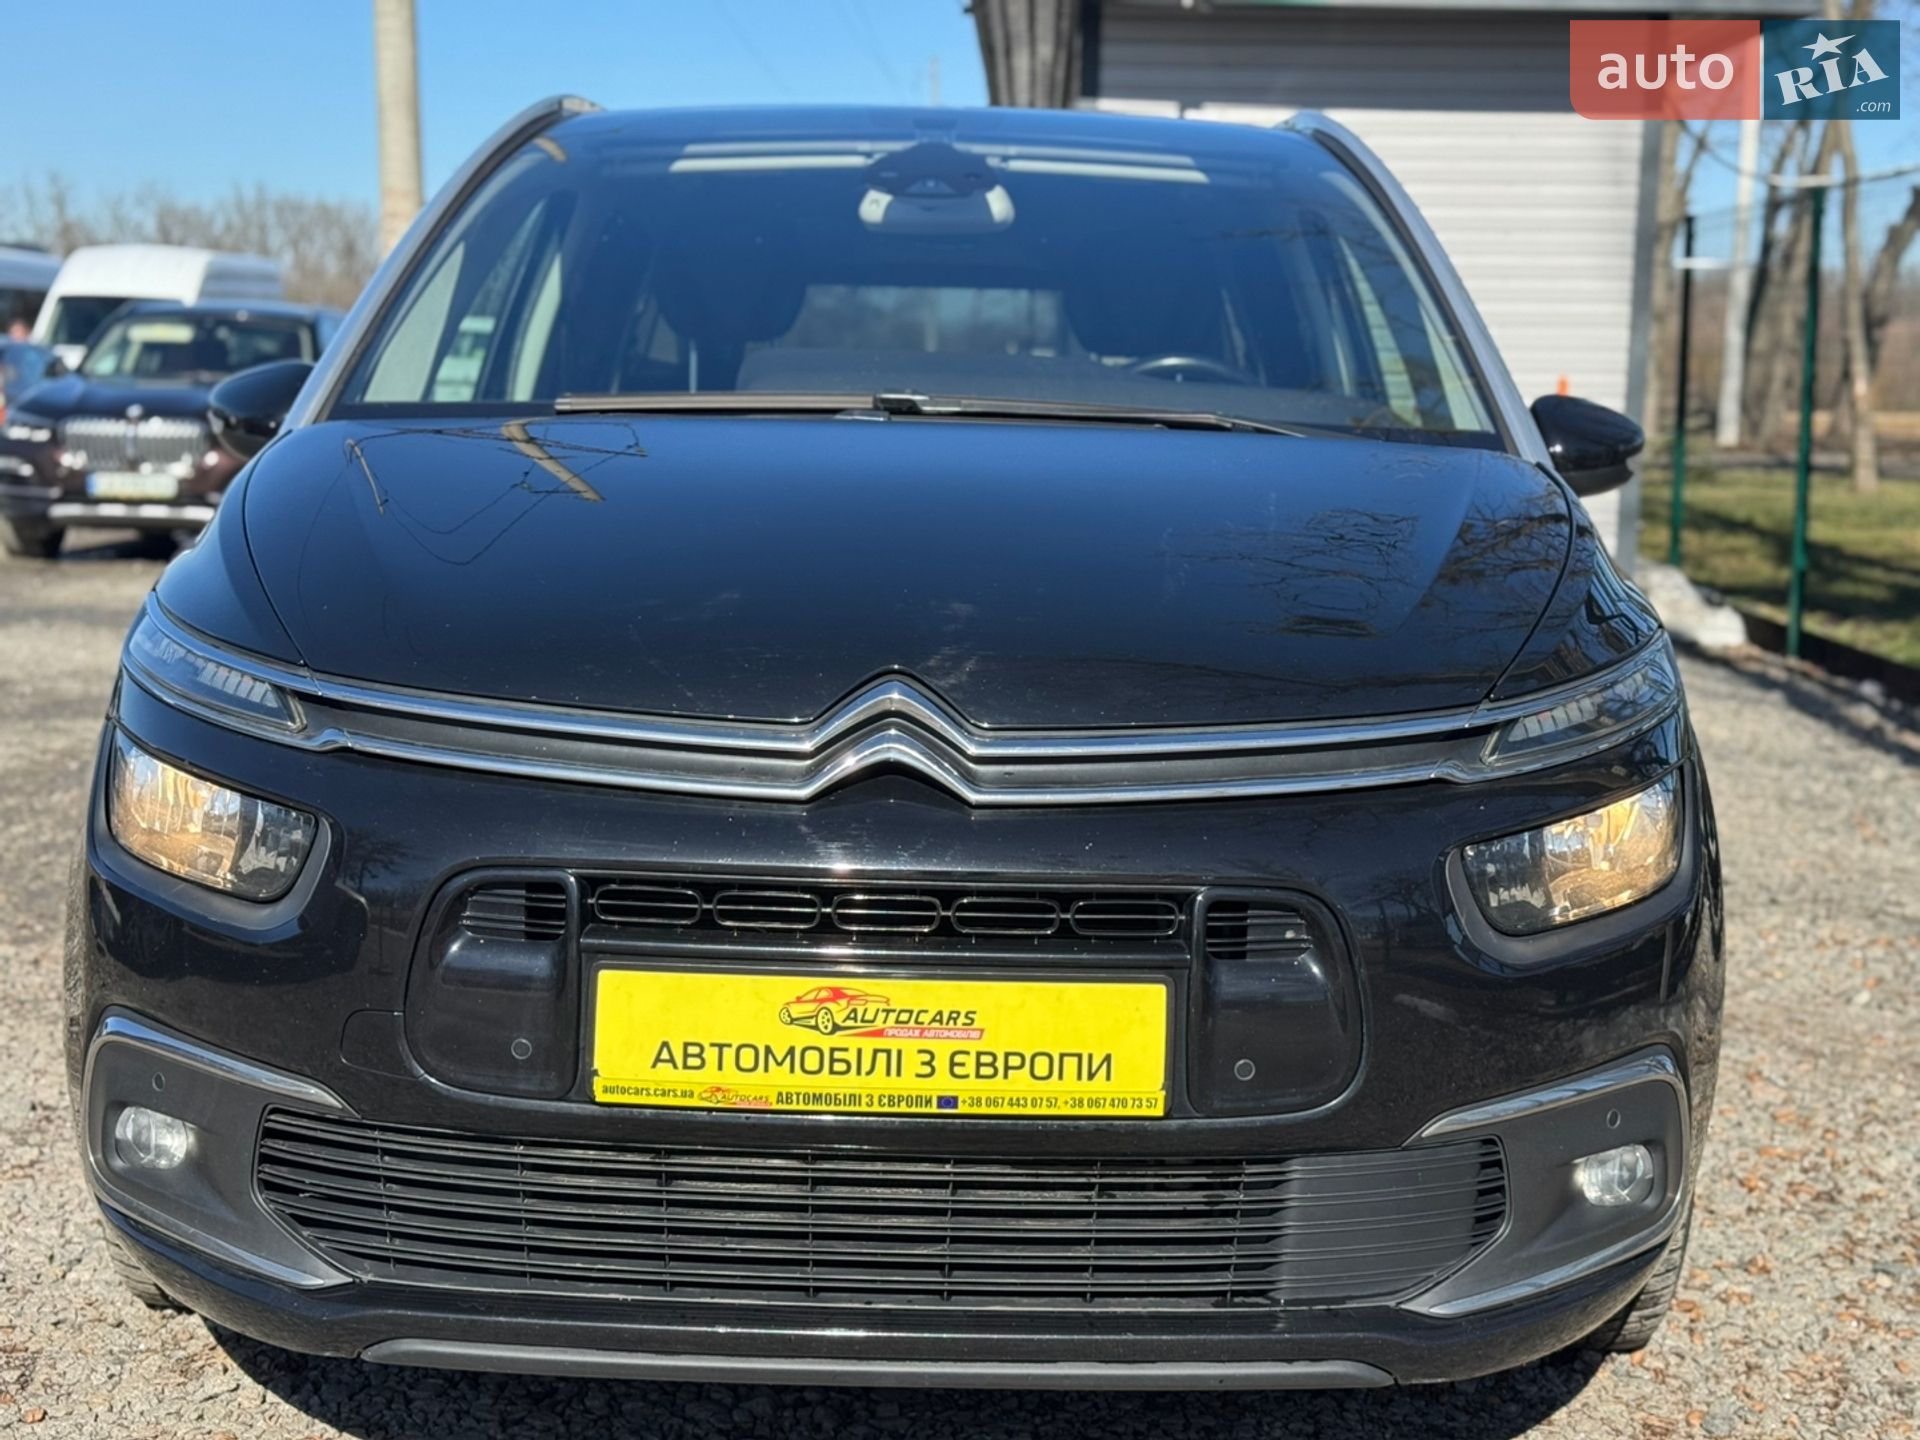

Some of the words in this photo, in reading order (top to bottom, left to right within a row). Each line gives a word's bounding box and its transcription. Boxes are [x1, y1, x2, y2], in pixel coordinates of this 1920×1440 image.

[842, 1007, 977, 1026] AUTOCARS
[650, 1040, 903, 1077] АВТОМОБІЛІ
[948, 1050, 1112, 1082] ЄВРОПИ
[602, 1083, 694, 1099] autocars.cars.ua
[776, 1091, 862, 1106] АВТОМОБІЛІ
[878, 1095, 933, 1109] ЄВРОПИ
[961, 1096, 983, 1108] +38
[985, 1096, 1006, 1108] 067
[1007, 1097, 1028, 1109] 443
[1063, 1097, 1084, 1109] +38
[1087, 1097, 1107, 1109] 067
[1109, 1097, 1128, 1109] 470
[1130, 1097, 1143, 1109] 73
[1146, 1097, 1158, 1109] 57
